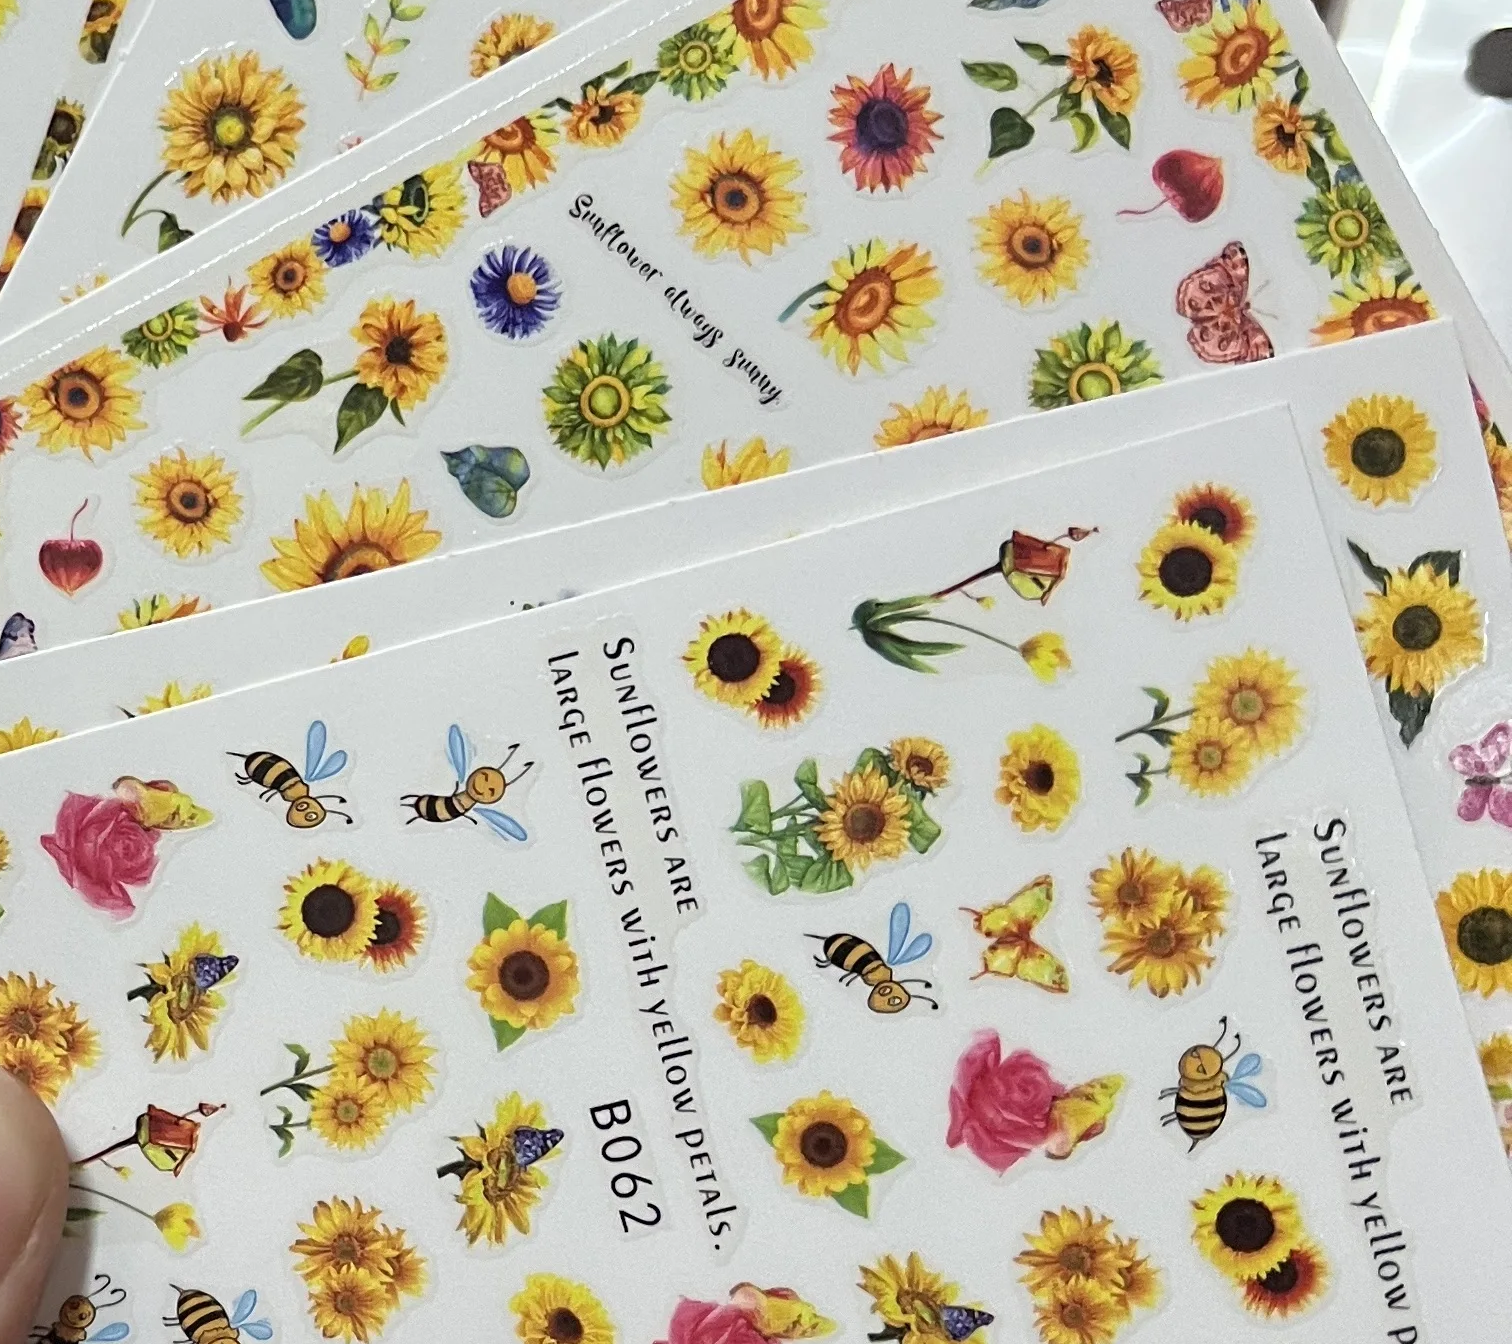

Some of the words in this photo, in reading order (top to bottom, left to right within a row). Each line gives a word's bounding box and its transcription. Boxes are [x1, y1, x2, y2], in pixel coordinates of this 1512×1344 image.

[568, 193, 664, 283] Sunflower
[664, 286, 724, 348] always
[589, 1098, 662, 1234] B062
